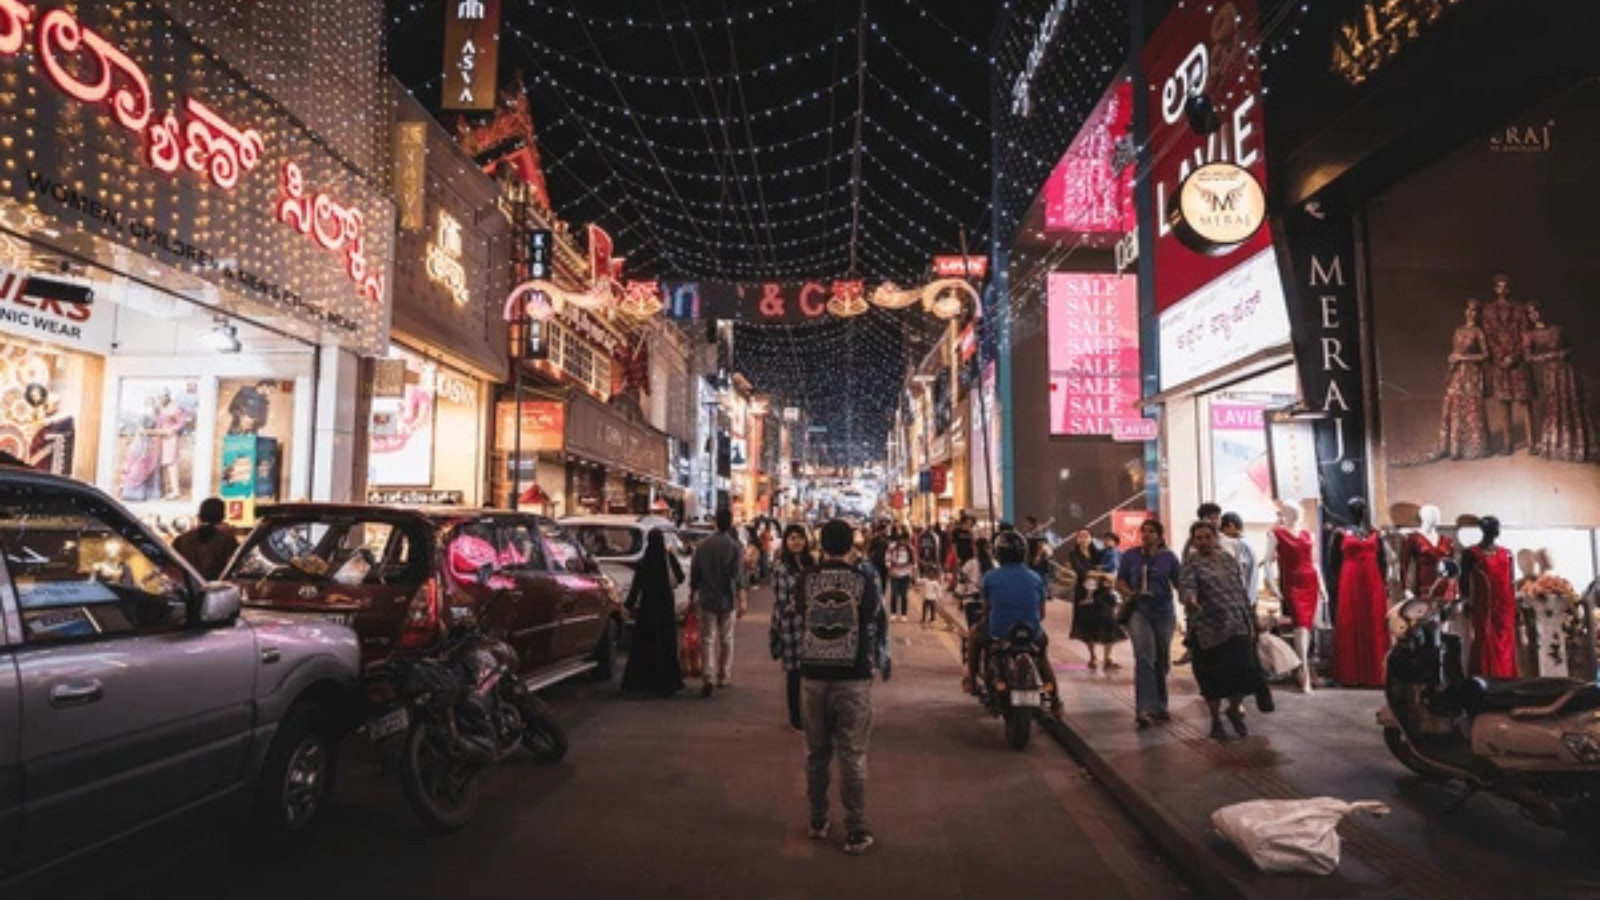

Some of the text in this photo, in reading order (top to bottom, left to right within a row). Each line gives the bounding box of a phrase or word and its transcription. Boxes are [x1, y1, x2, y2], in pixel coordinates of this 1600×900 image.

[459, 22, 476, 102] ASVA
[1066, 279, 1118, 297] SALE
[1067, 299, 1118, 316] SALE
[33, 316, 82, 339] WEAR
[1068, 319, 1118, 336] SALE
[1068, 338, 1120, 355] SALE
[1069, 358, 1121, 376] SALE
[1308, 254, 1352, 462] MERAJ
[1069, 378, 1121, 395] SALE
[1070, 397, 1122, 414] SALE
[1213, 408, 1263, 426] LAVIE
